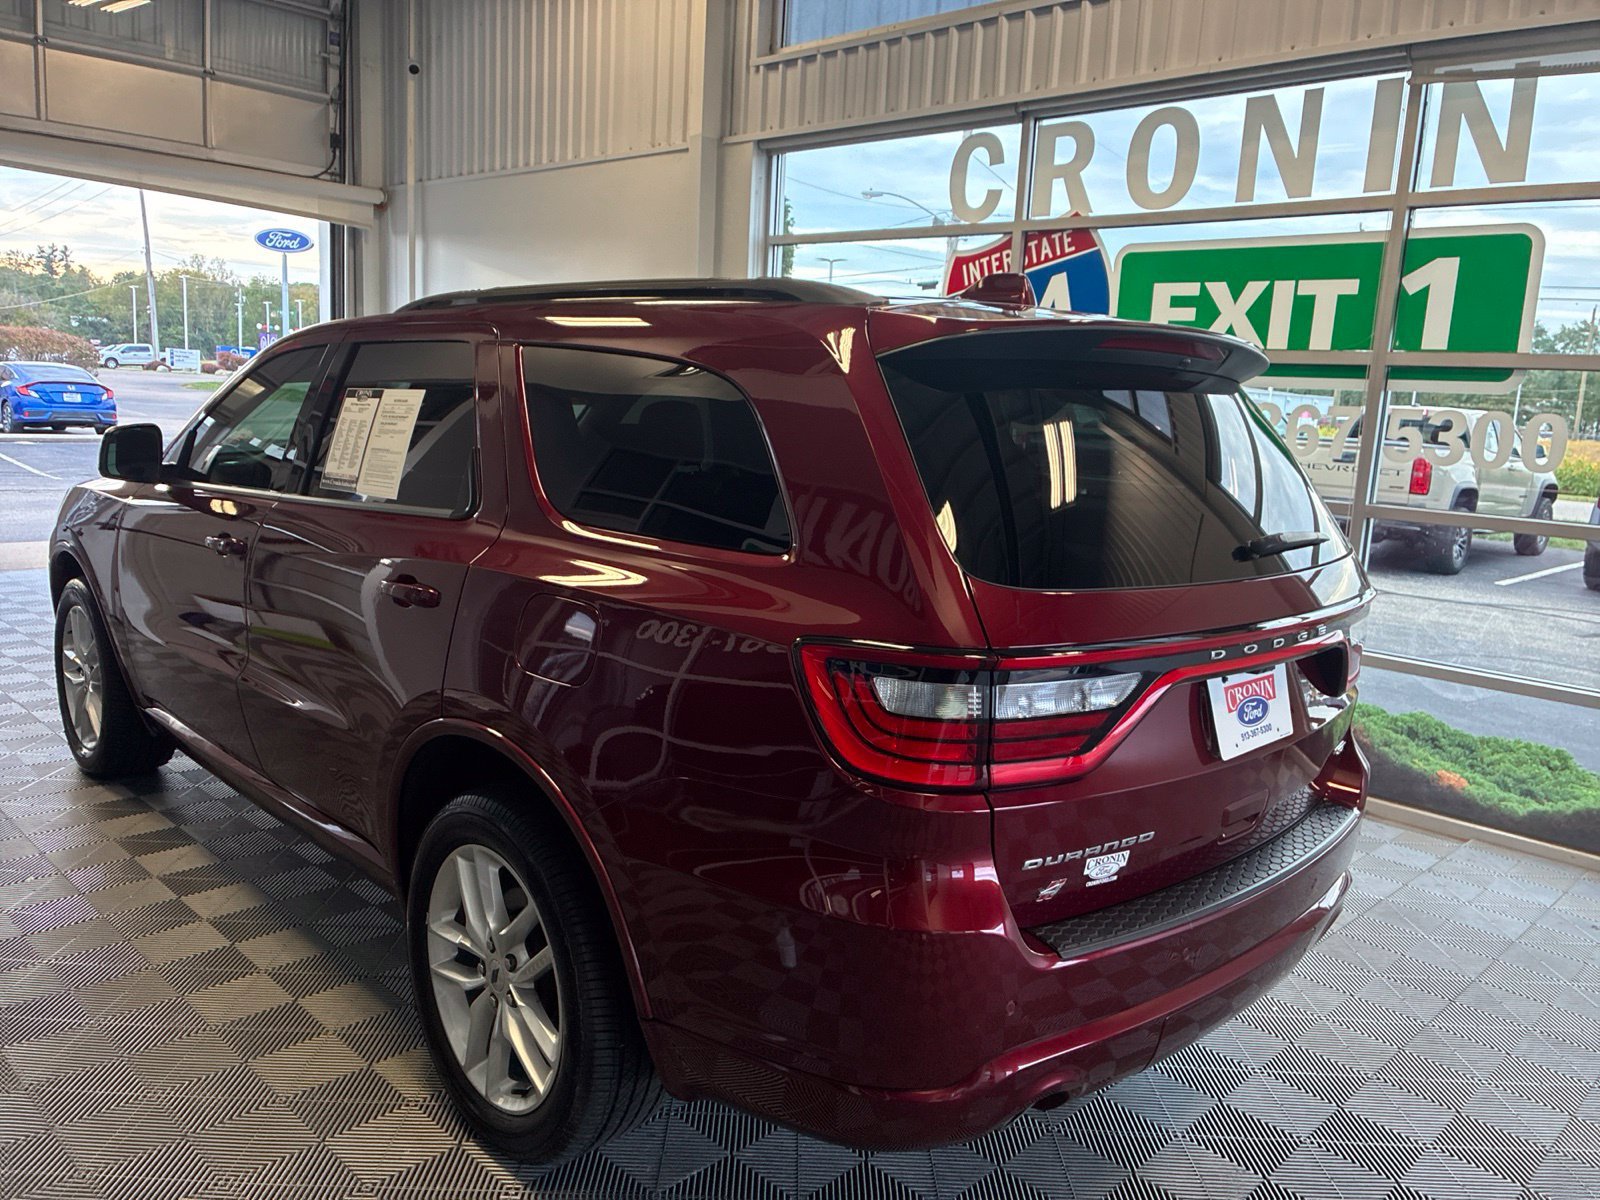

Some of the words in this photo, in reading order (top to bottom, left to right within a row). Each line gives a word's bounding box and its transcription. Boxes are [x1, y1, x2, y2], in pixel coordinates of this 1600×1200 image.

[949, 76, 1538, 223] CRONIN
[265, 231, 301, 249] Ford
[962, 229, 1076, 288] INTERTATE
[1150, 277, 1361, 351] EXIT
[1401, 256, 1460, 351] 1
[1210, 625, 1327, 659] DODGE
[1227, 677, 1274, 711] CRONIN
[1243, 701, 1264, 721] Ford
[1241, 723, 1273, 742] 513-367-5300
[1022, 831, 1155, 870] DURANGO
[1086, 851, 1128, 871] CRONIN
